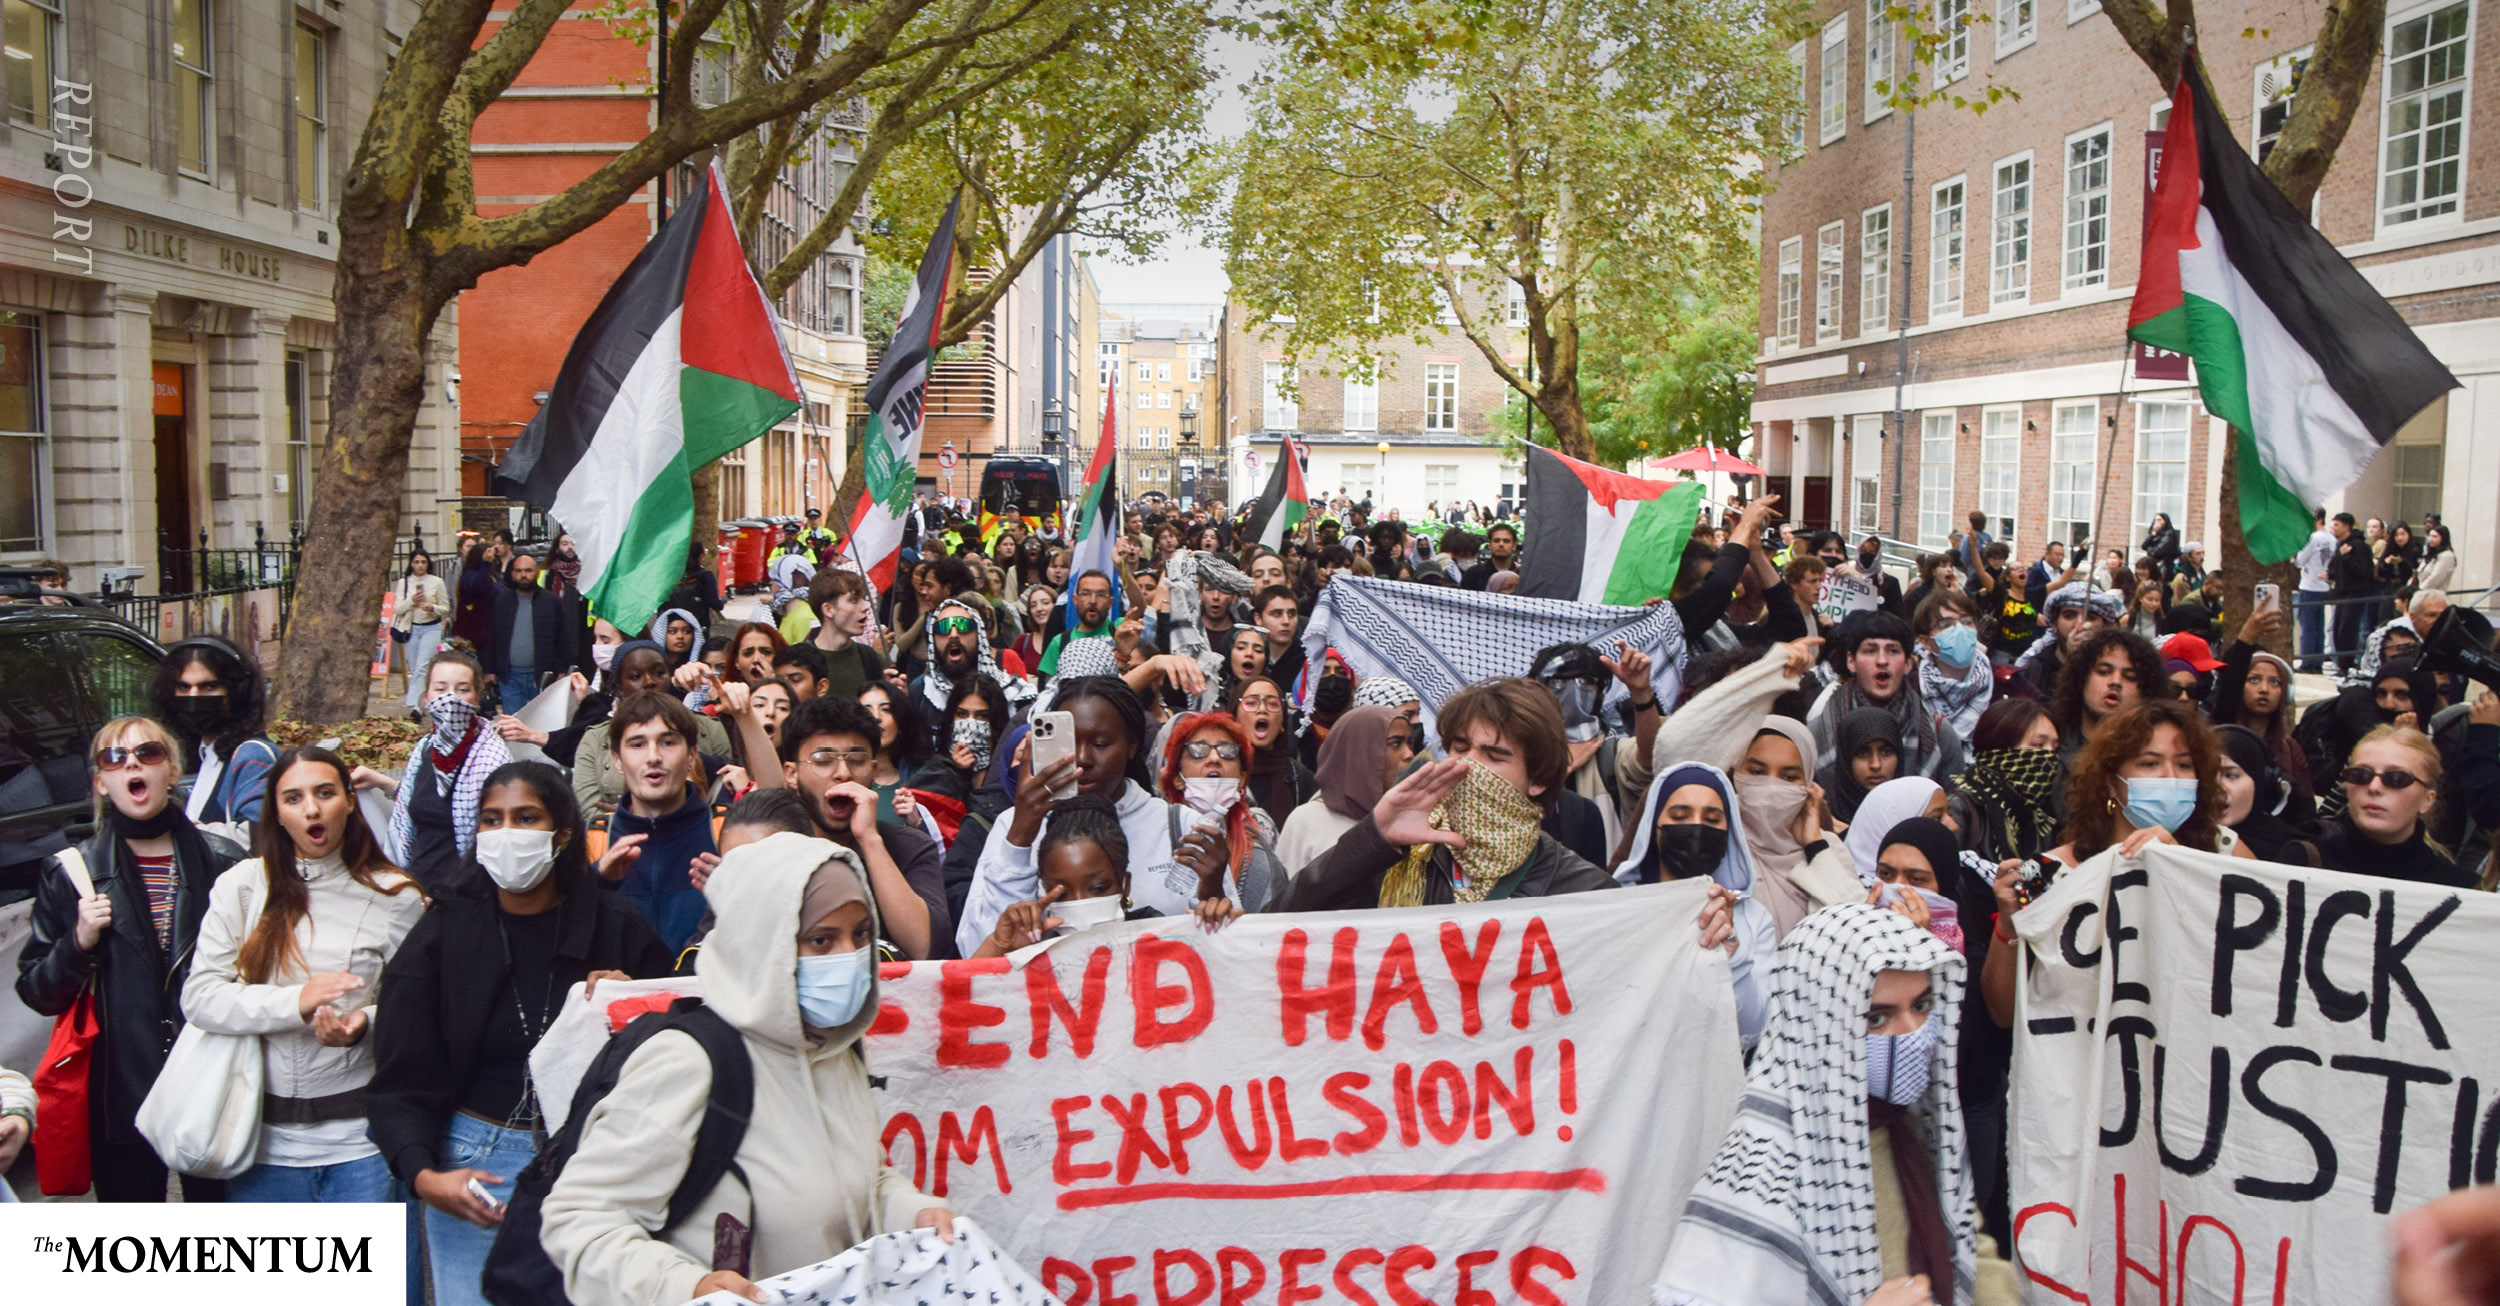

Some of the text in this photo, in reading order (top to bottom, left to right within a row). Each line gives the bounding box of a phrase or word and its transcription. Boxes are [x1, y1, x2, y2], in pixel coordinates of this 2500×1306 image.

[125, 225, 280, 281] DILKE HOUSE
[1822, 572, 1870, 596] RTHEID
[1277, 917, 1574, 1050] HAYA
[2211, 874, 2463, 1050] PICK
[880, 1038, 1577, 1198] OM EXPULSION!
